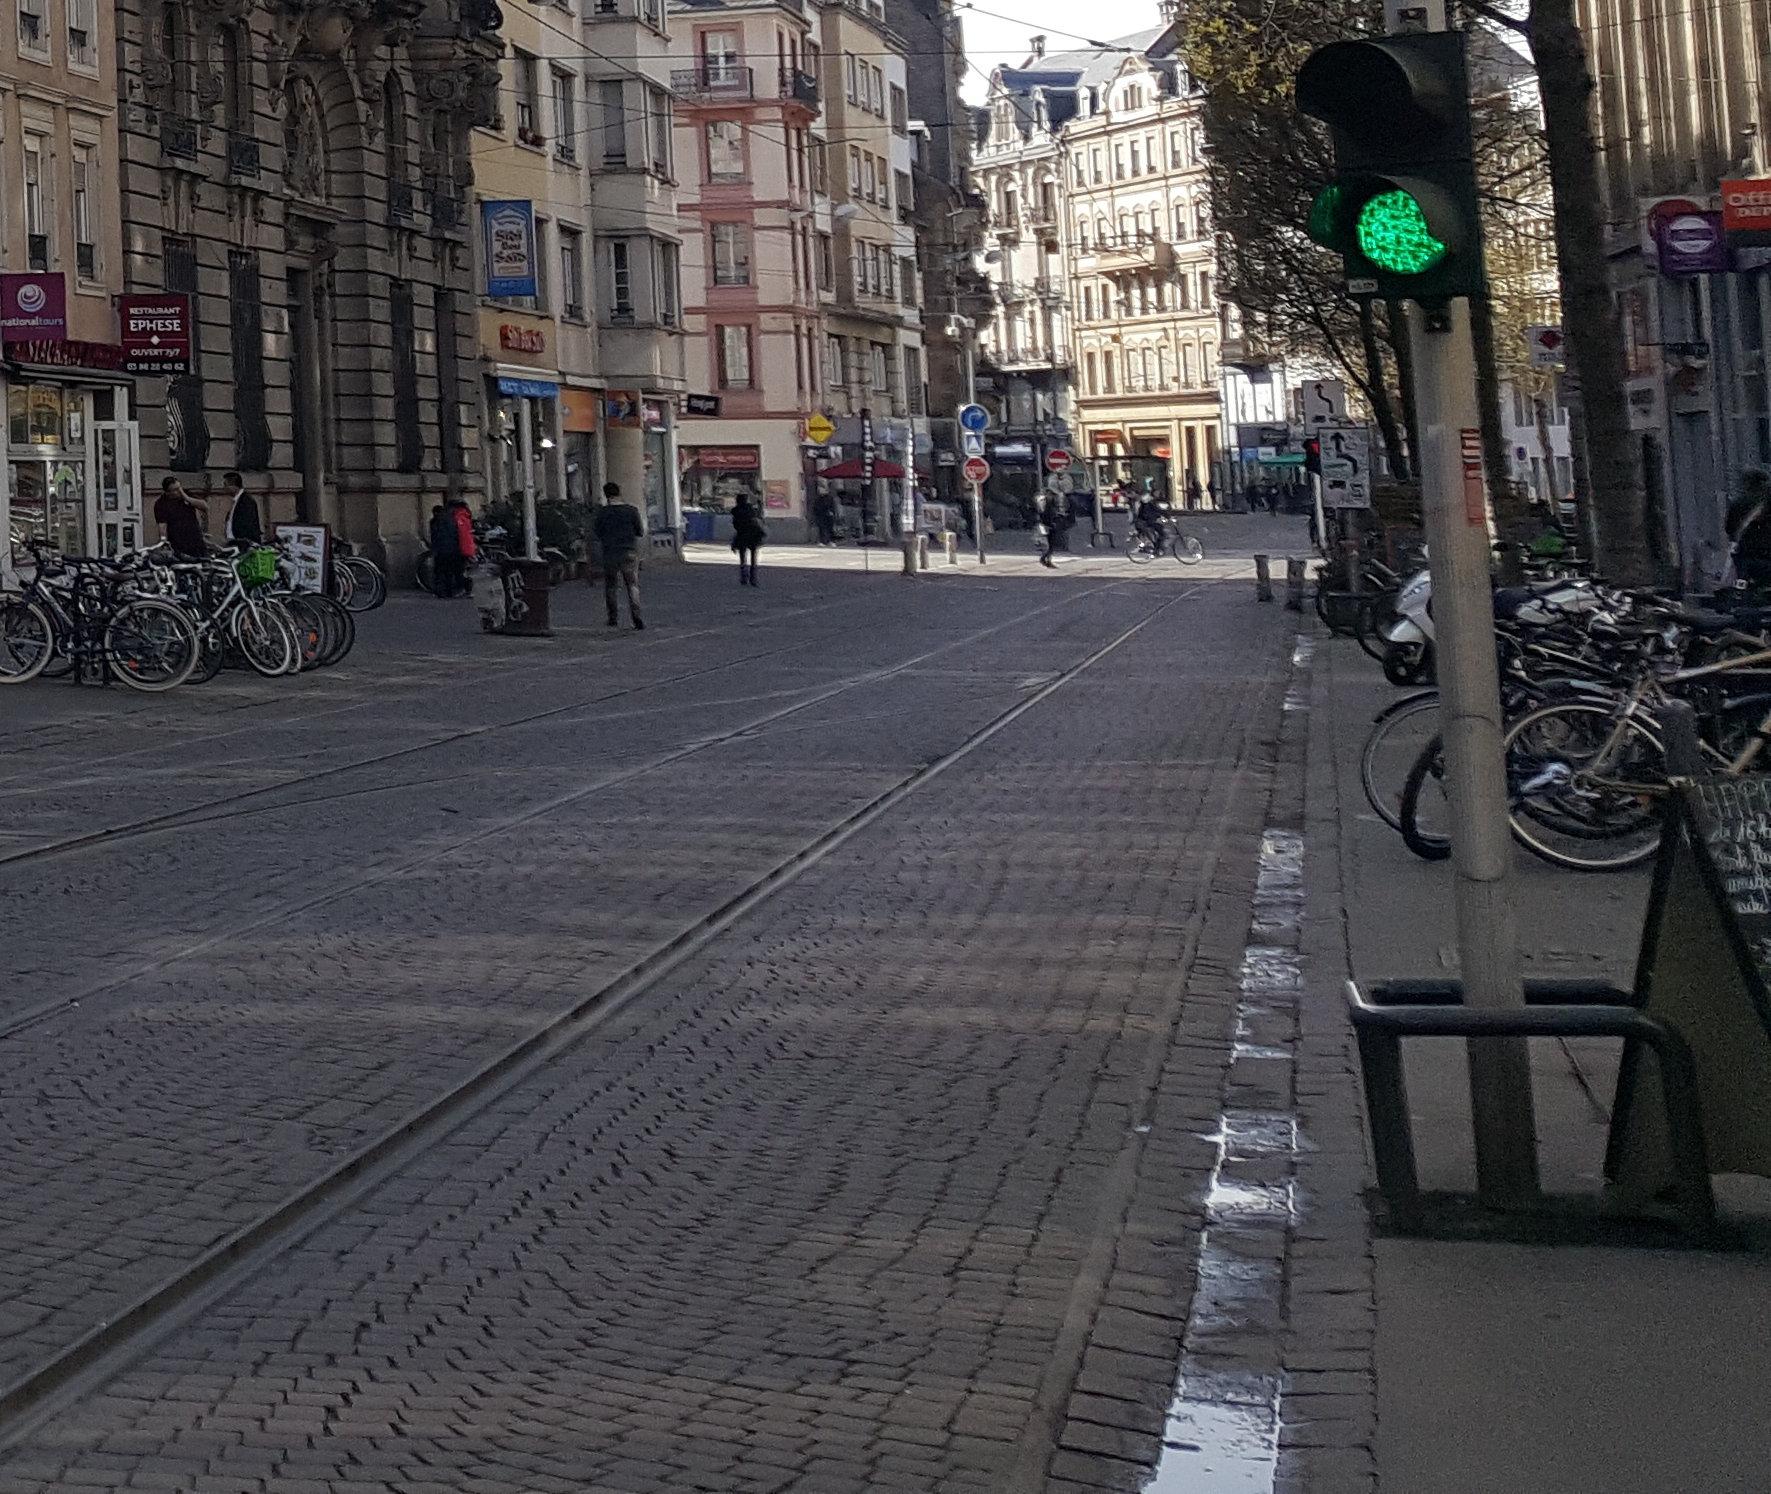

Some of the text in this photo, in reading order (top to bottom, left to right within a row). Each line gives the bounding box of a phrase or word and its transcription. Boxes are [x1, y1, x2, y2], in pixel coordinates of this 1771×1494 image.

[0, 316, 64, 327] nationaltours
[130, 319, 181, 331] EPHESE
[131, 348, 164, 356] OUVERT
